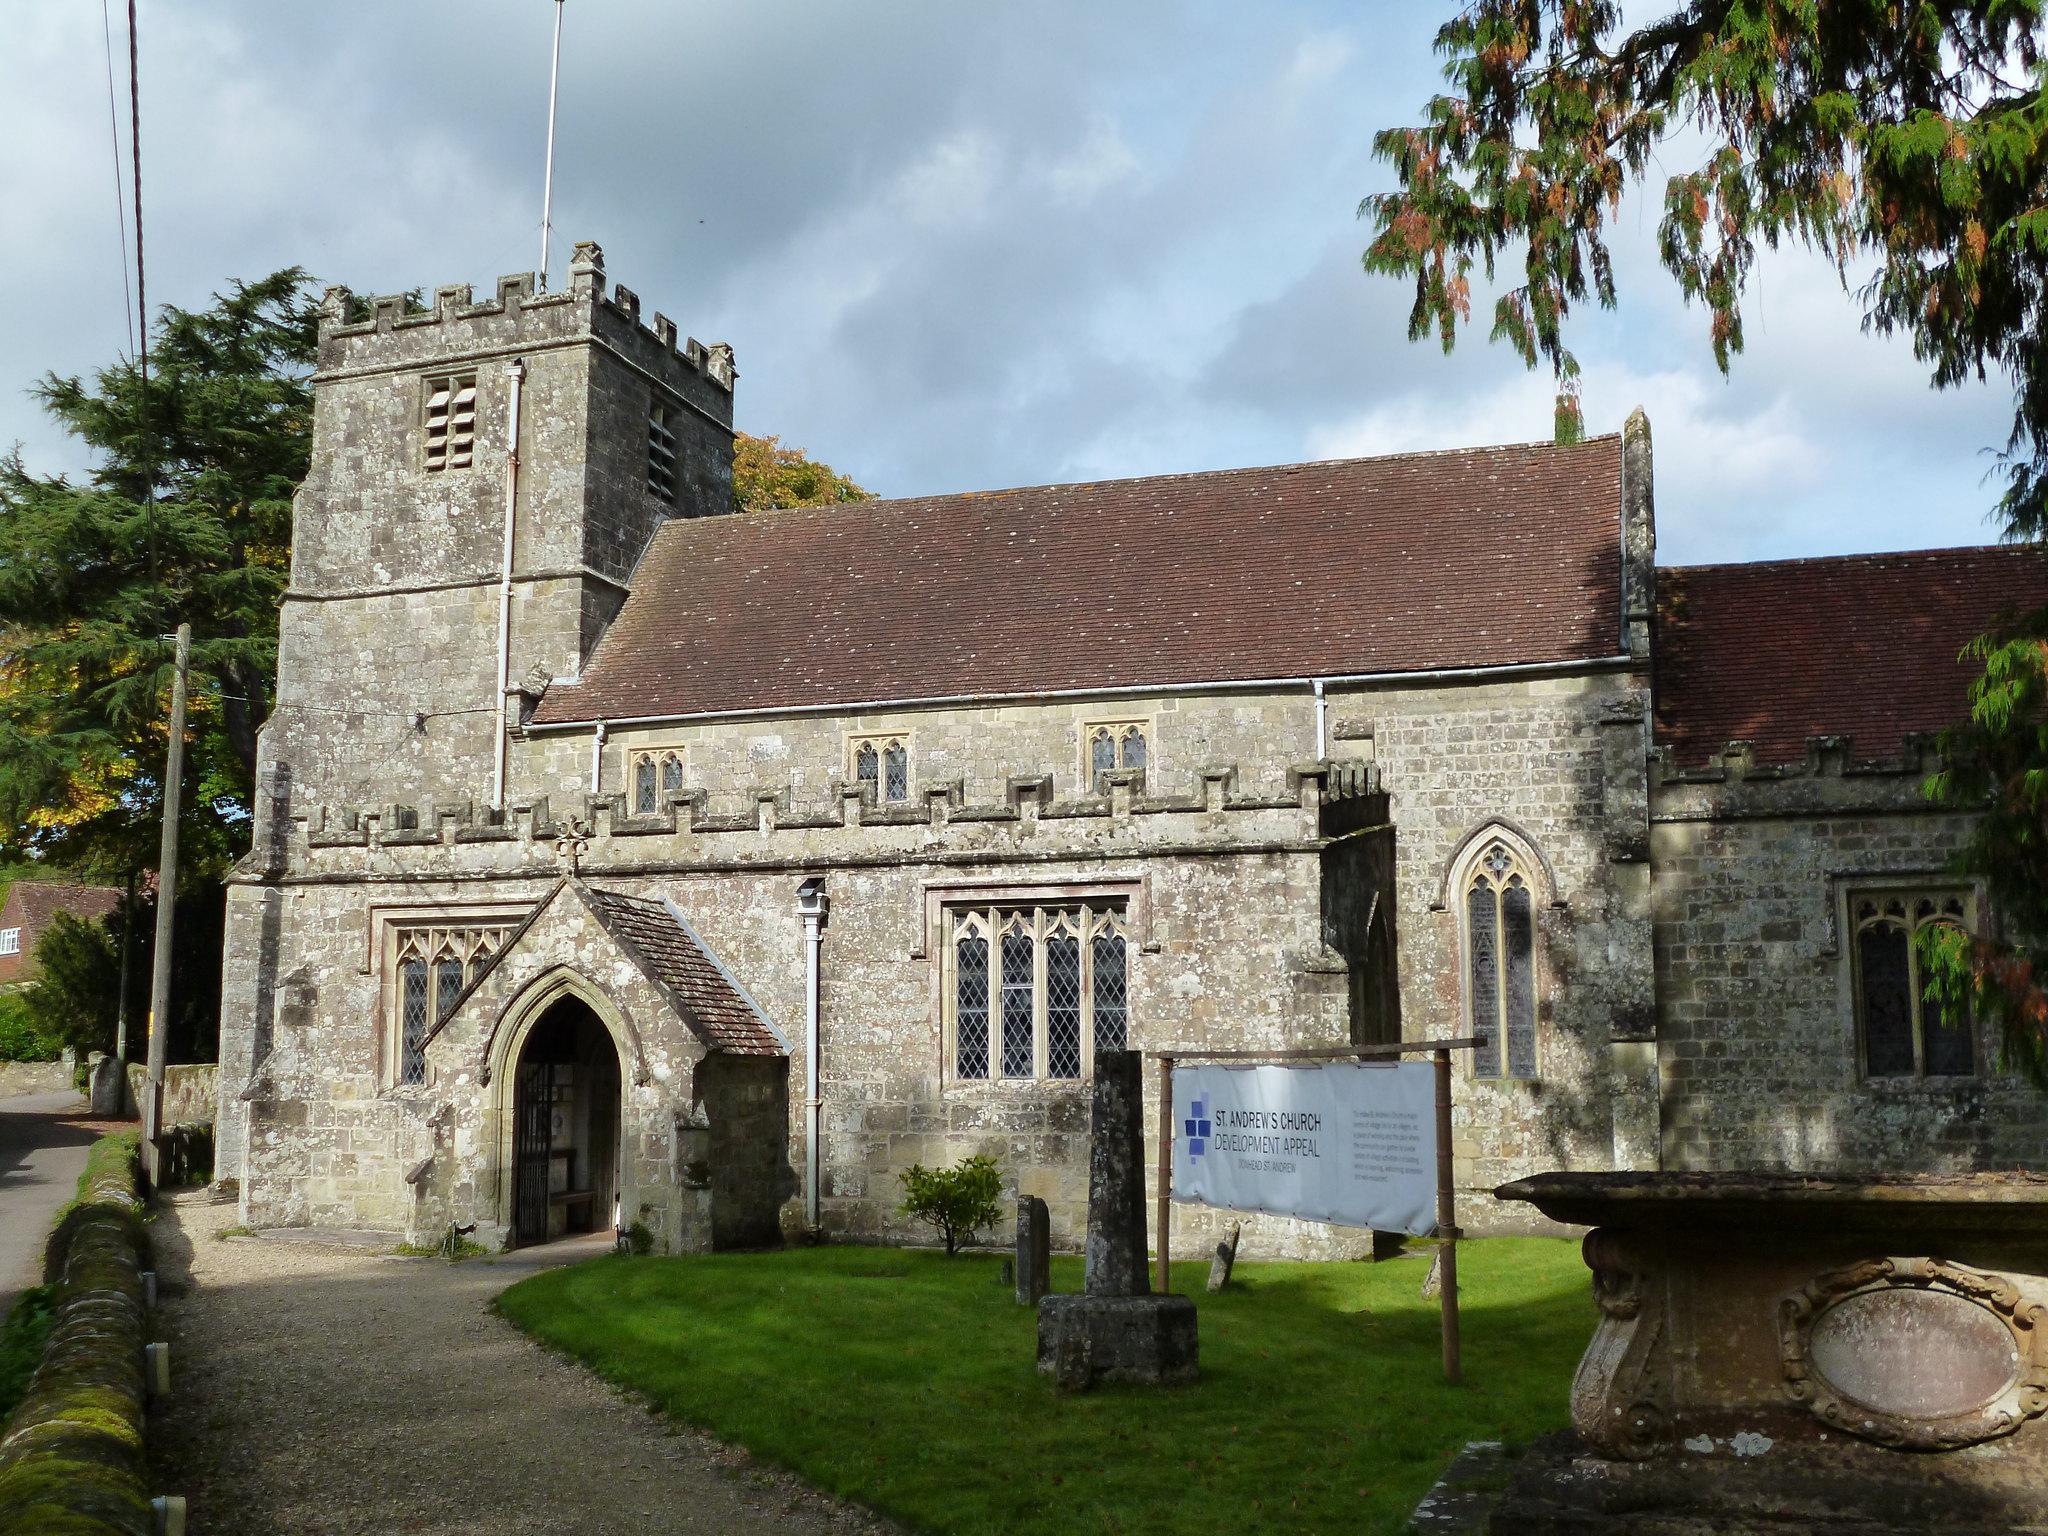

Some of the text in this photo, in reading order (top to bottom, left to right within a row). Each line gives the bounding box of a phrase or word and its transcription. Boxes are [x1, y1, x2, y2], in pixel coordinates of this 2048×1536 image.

[1215, 1110, 1322, 1131] ST. ANDREW'S CHURCH
[1214, 1133, 1320, 1157] DEVELOPMENT APPEAL
